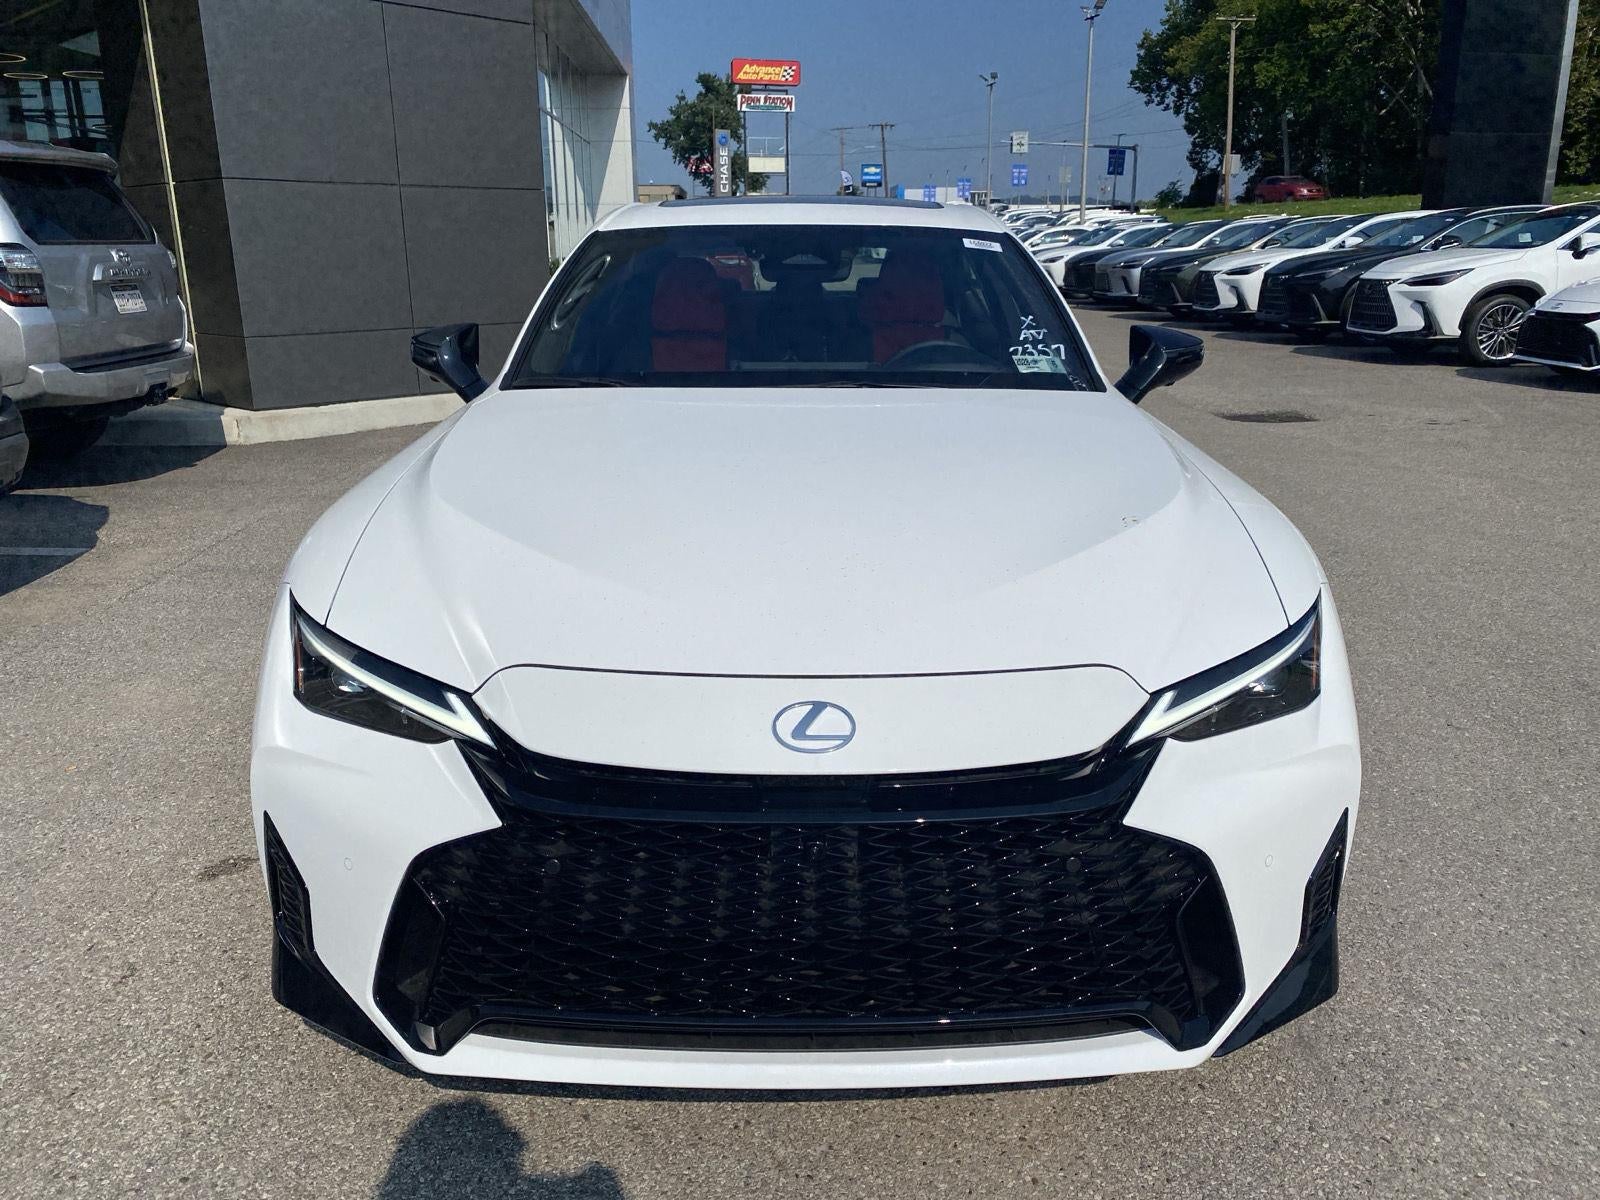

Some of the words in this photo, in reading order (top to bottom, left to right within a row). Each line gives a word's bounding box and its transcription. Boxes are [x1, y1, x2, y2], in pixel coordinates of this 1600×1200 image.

[741, 64, 781, 74] Advance
[736, 72, 757, 80] Auto
[757, 72, 780, 80] Parts
[740, 95, 761, 111] PENN
[763, 95, 793, 111] STATION
[720, 147, 729, 193] CHASE
